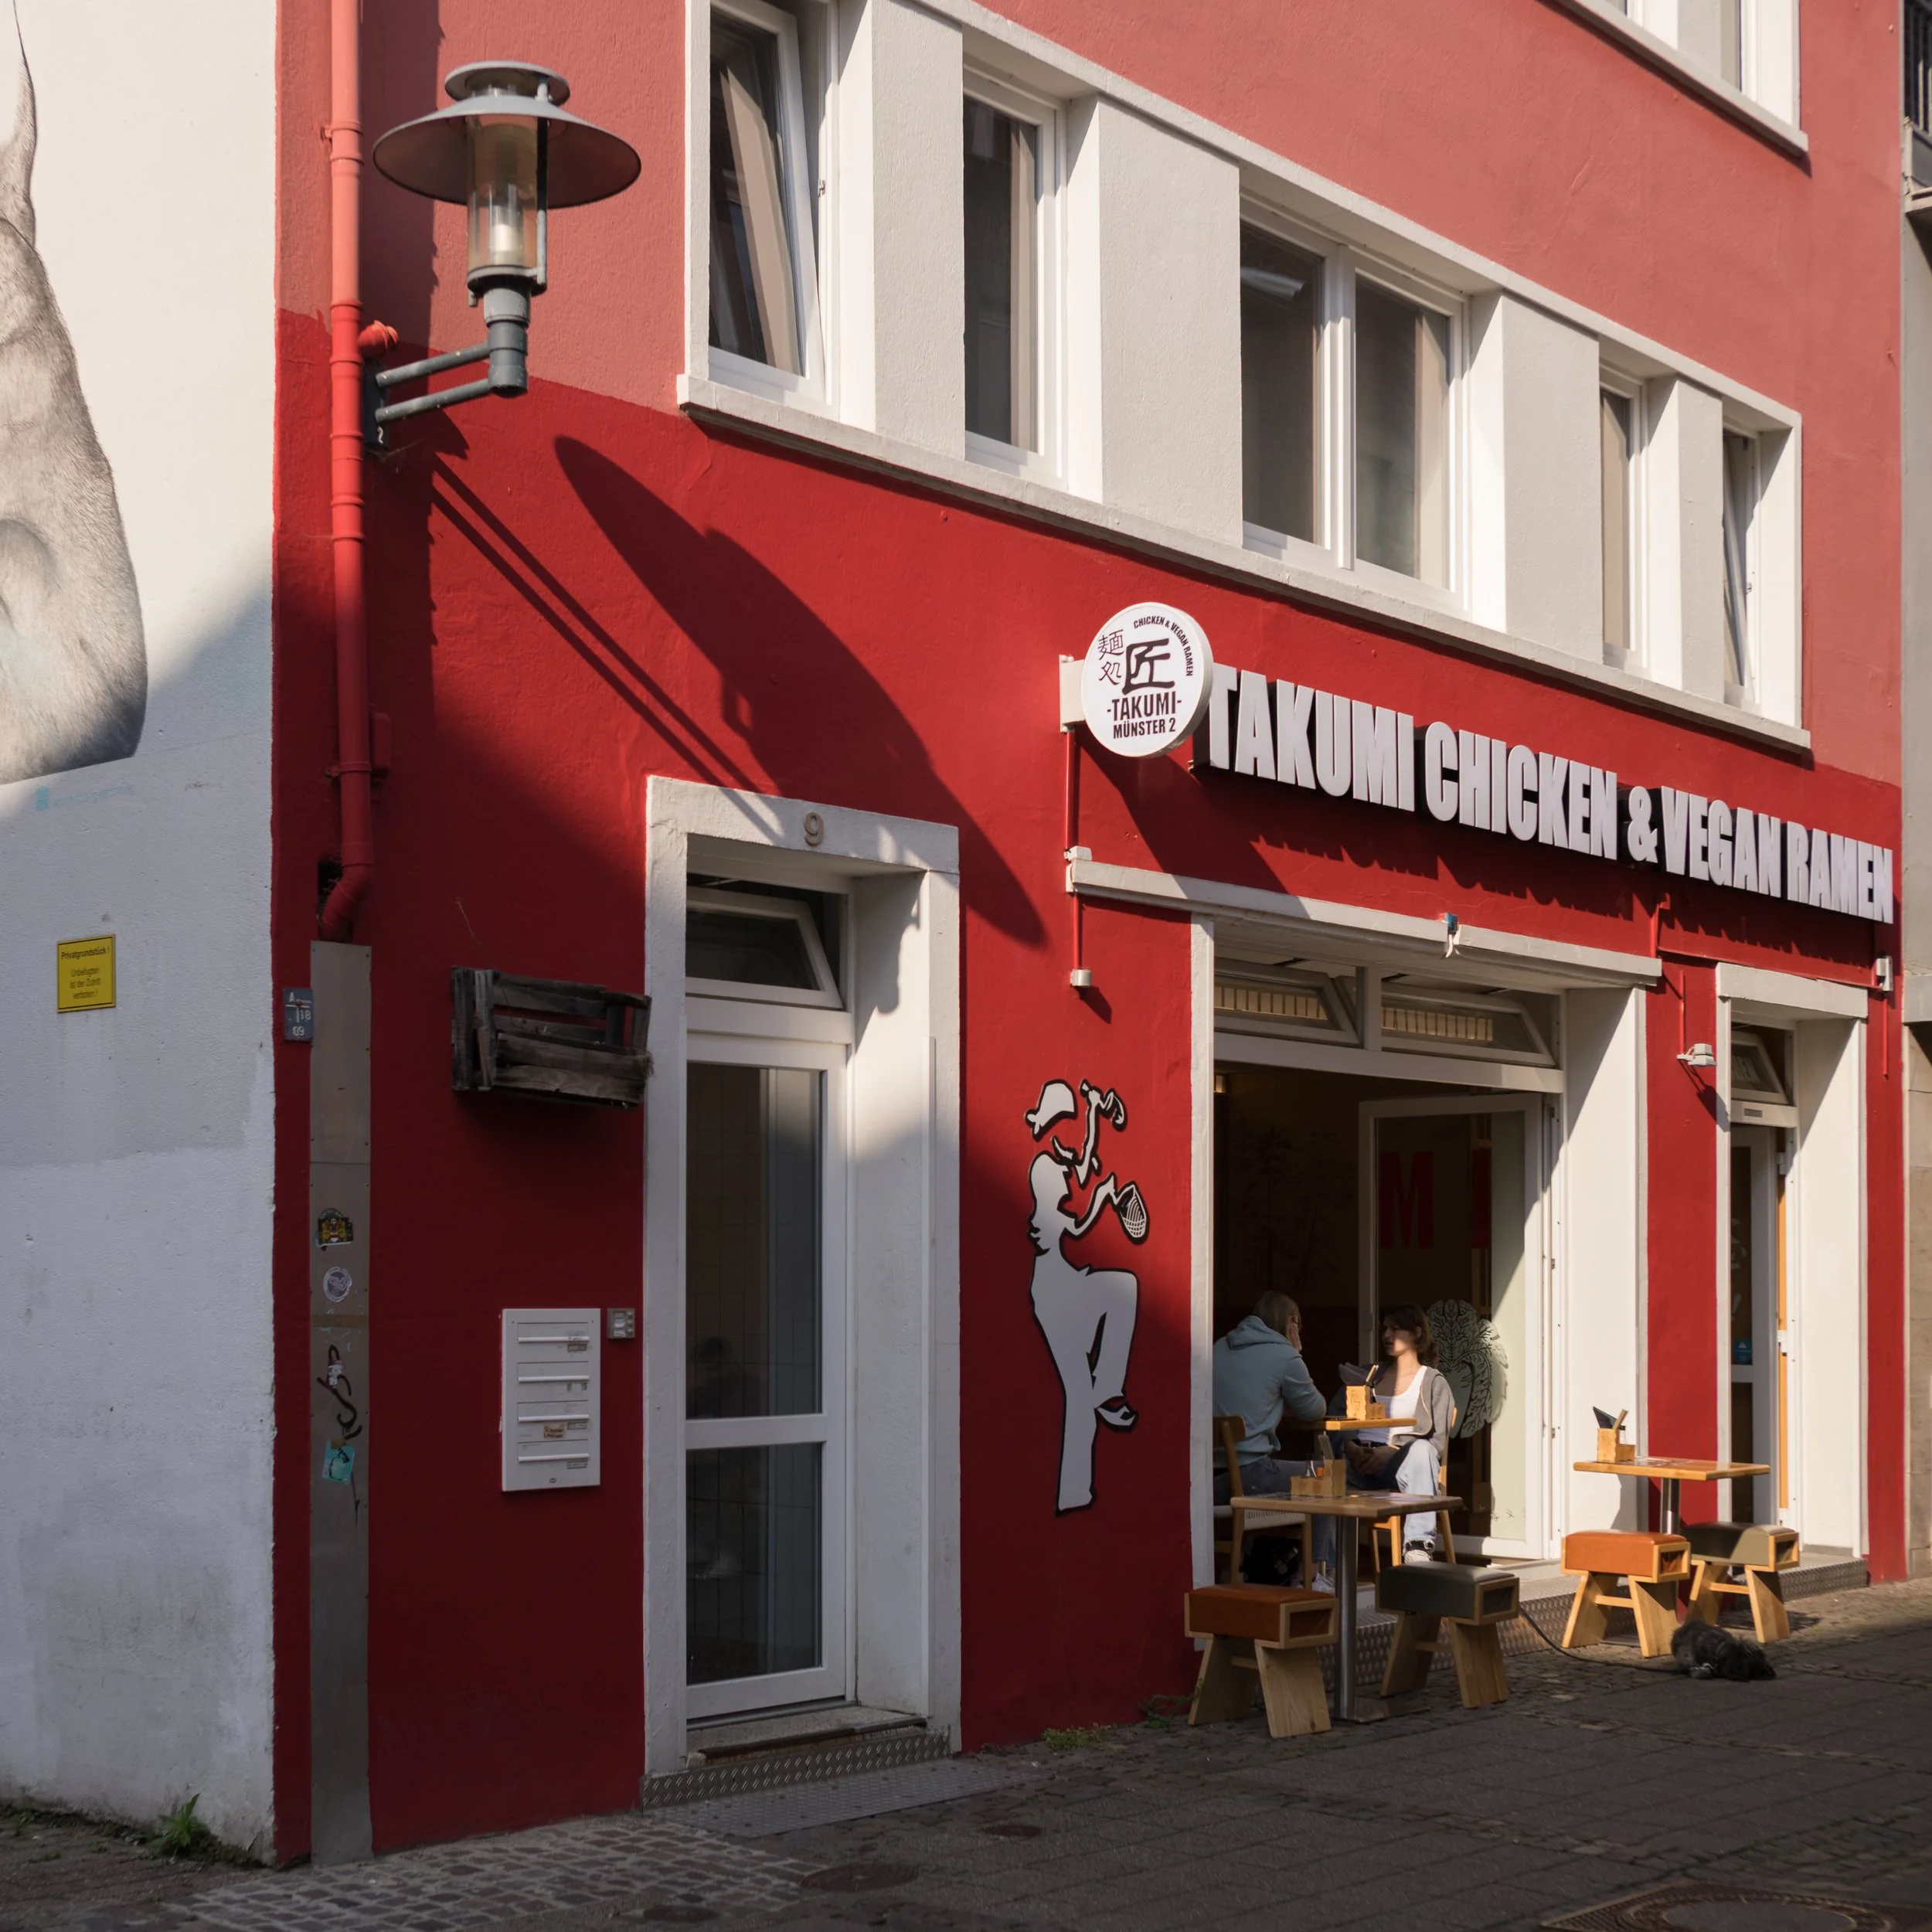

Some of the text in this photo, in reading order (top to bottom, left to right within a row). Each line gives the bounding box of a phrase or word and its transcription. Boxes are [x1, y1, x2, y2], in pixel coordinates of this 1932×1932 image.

[1121, 638, 1175, 696] 匠
[1133, 615, 1194, 676] CHICKEN & VEGAN RAMEN
[1113, 717, 1176, 739] MÜNSTER 2
[1209, 662, 1893, 924] TAKUMI CHICKEN & VEGAN RAMEN
[804, 811, 824, 847] 9
[289, 992, 295, 1002] A
